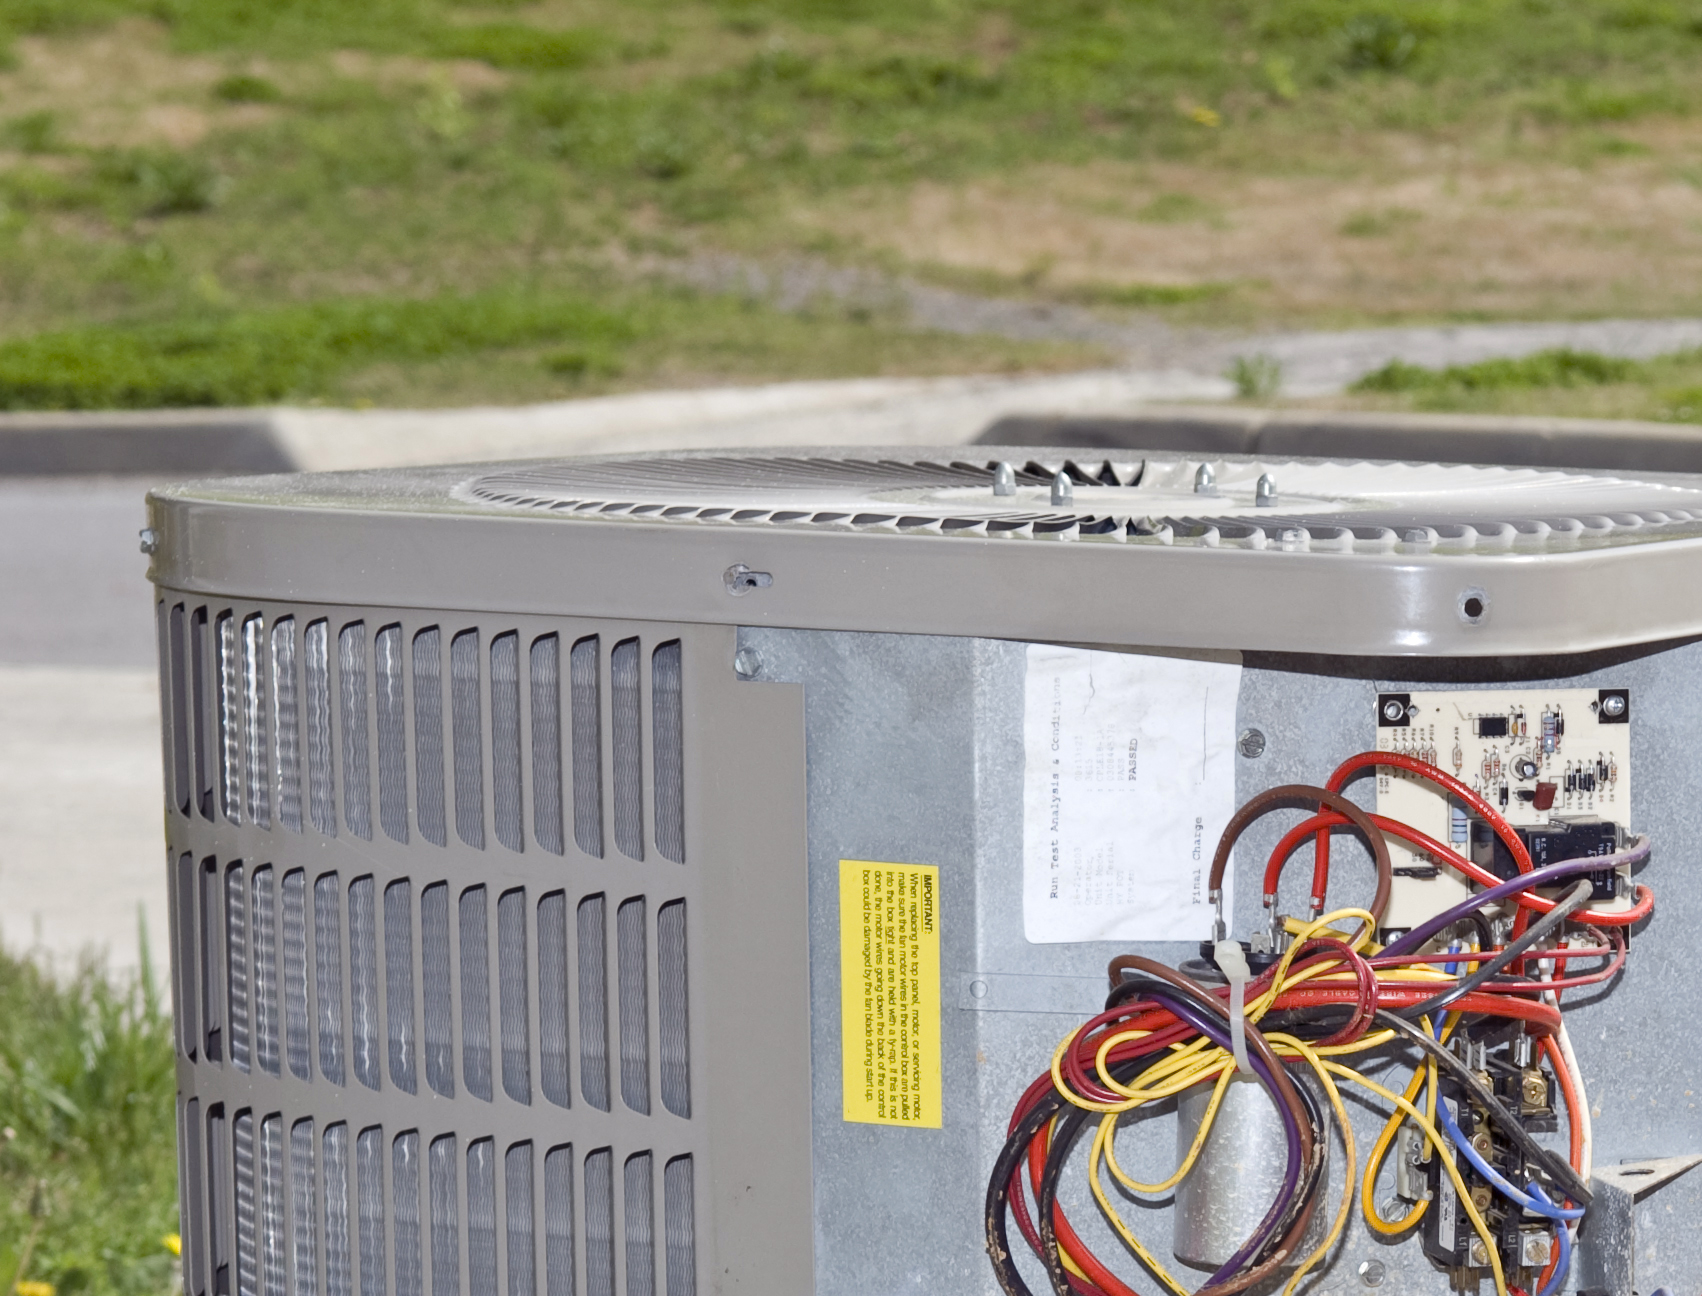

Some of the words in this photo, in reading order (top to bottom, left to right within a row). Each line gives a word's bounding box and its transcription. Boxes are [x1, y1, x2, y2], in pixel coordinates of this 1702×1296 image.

[1128, 738, 1138, 781] PASSED
[1050, 773, 1061, 832] Analysis
[1192, 817, 1203, 860] Charge
[1050, 839, 1059, 870] Test
[886, 871, 894, 887] into
[898, 872, 906, 896] make
[910, 873, 919, 899] When
[1050, 877, 1058, 899] Run
[1192, 869, 1201, 905] Final
[863, 887, 871, 911] could
[924, 875, 933, 934] IMPORTANT:
[875, 914, 883, 939] motor
[909, 902, 919, 941] replacing
[863, 925, 872, 968] damaged
[876, 942, 884, 965] wires
[899, 950, 907, 976] motor
[875, 968, 884, 993] going
[900, 978, 908, 1001] wires
[876, 995, 885, 1019] down
[888, 986, 897, 1006] held
[865, 1013, 874, 1038] blade
[888, 1008, 897, 1026] with
[864, 1039, 874, 1067] during
[877, 1038, 885, 1059] back
[900, 1029, 909, 1059] control
[866, 1068, 874, 1088] start
[890, 1077, 898, 1092] this
[912, 1053, 921, 1091] servicing
[878, 1089, 886, 1118] control
[901, 1094, 910, 1120] pulled
